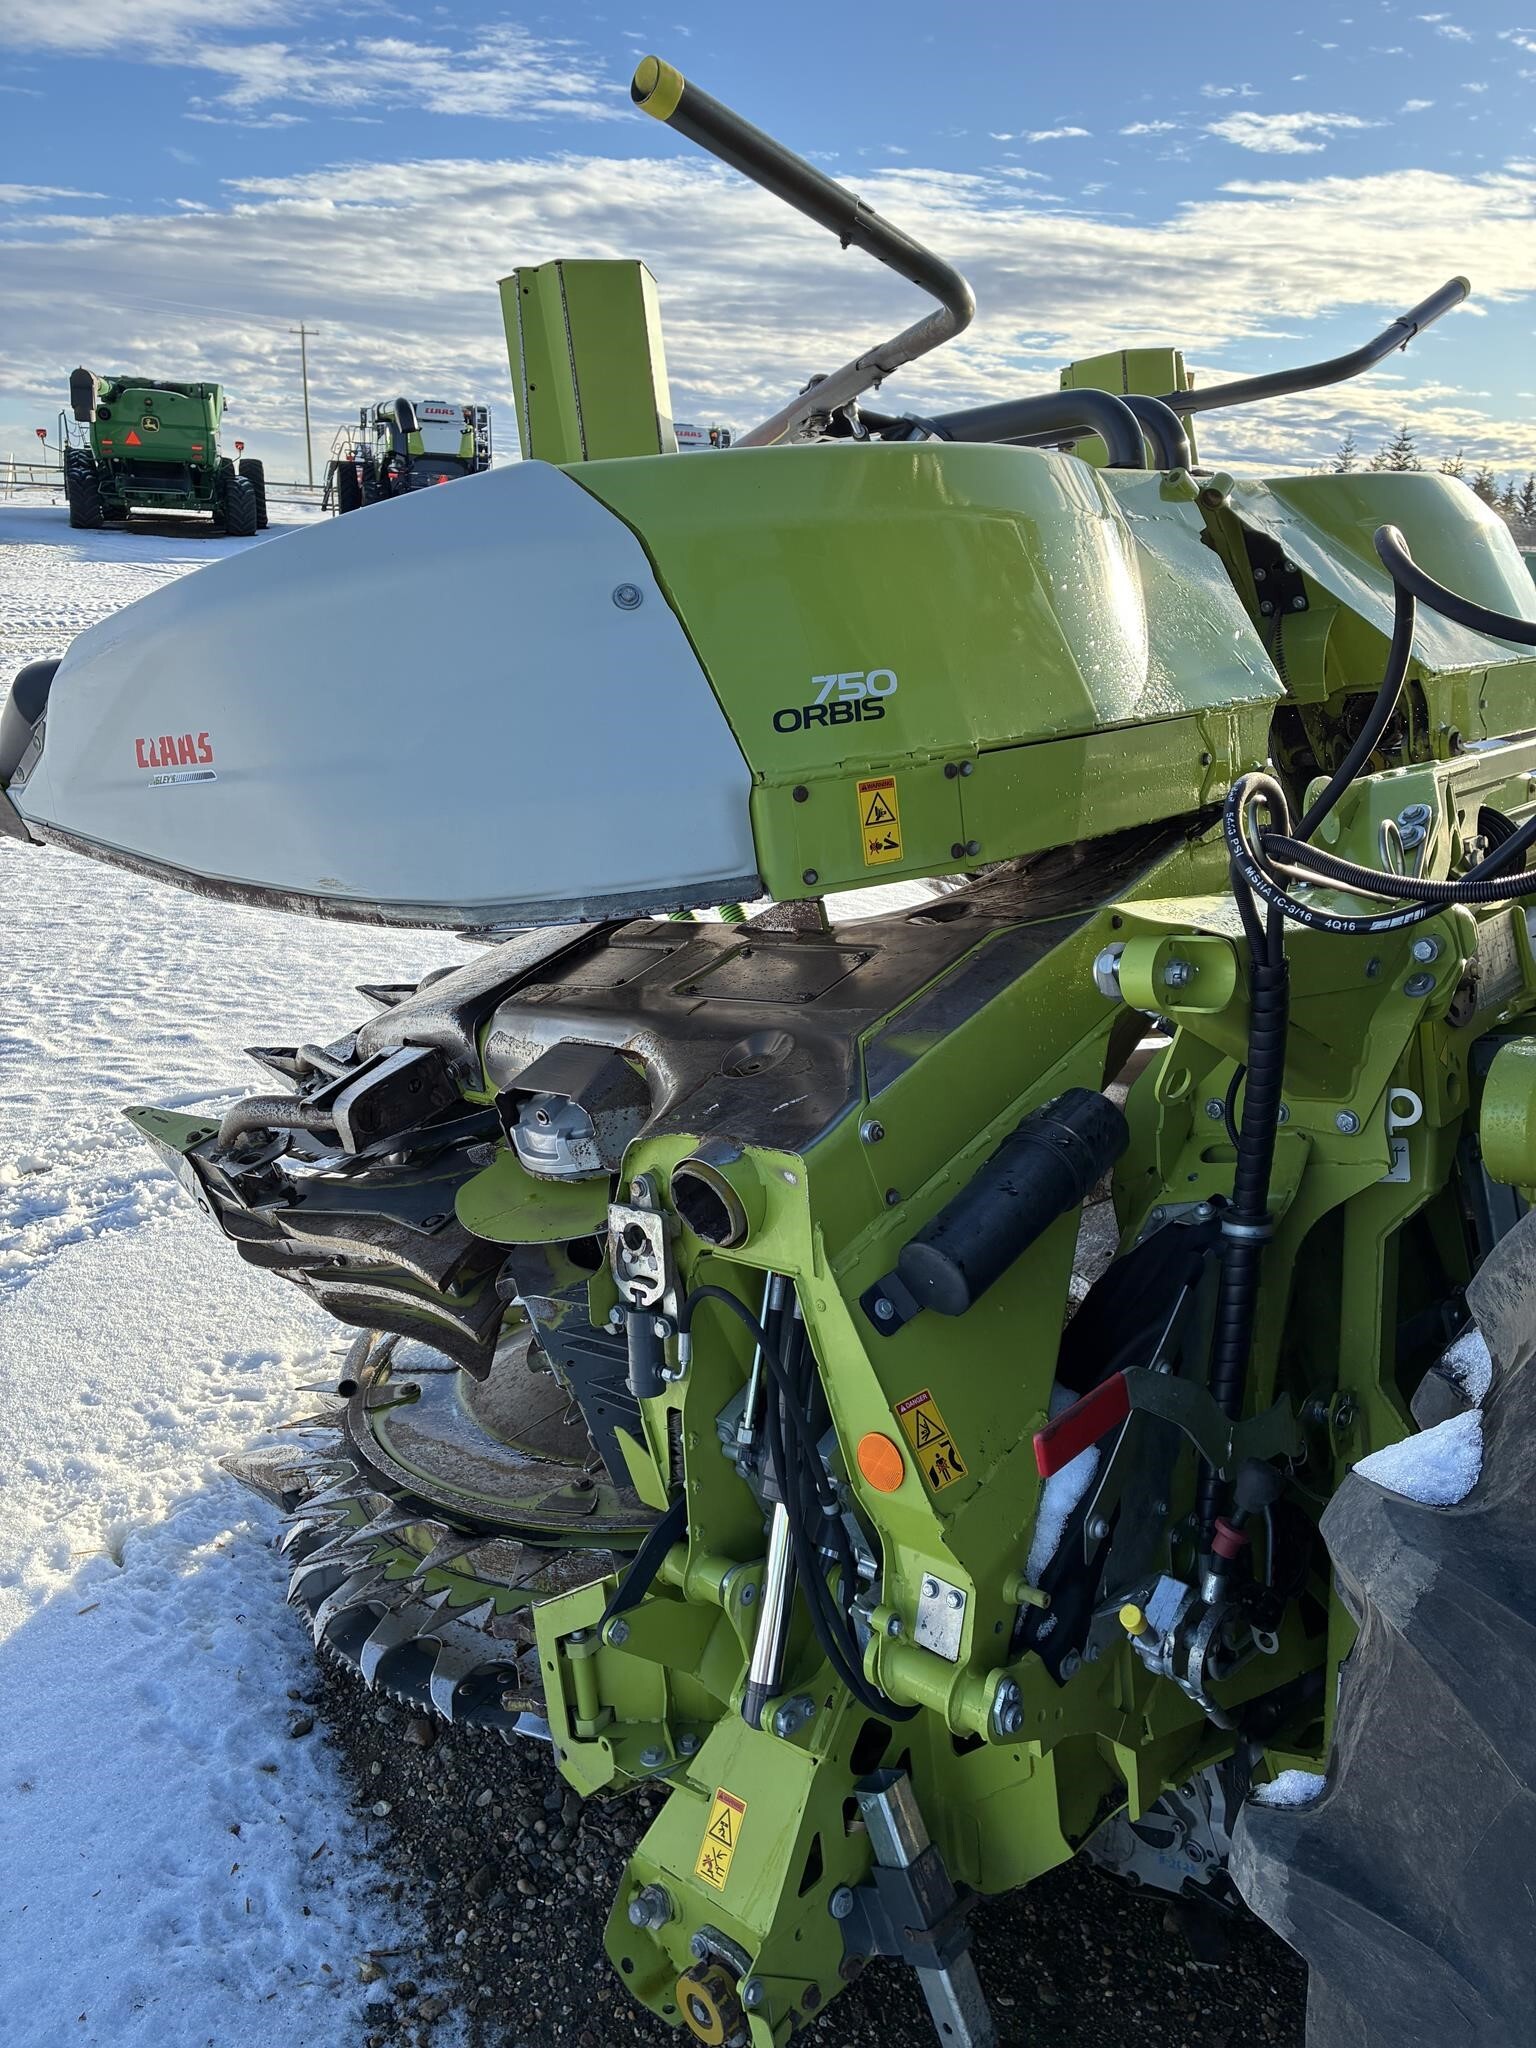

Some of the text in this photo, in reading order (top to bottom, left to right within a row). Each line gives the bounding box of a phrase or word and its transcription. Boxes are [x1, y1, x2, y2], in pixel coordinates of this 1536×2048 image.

[424, 407, 455, 416] CLAAS
[811, 669, 898, 705] 750
[772, 696, 886, 733] ORBIS
[135, 732, 213, 768] CLAAS
[1230, 838, 1244, 857] PSI
[1324, 918, 1356, 931] 4Q16
[905, 1393, 928, 1409] DANGER
